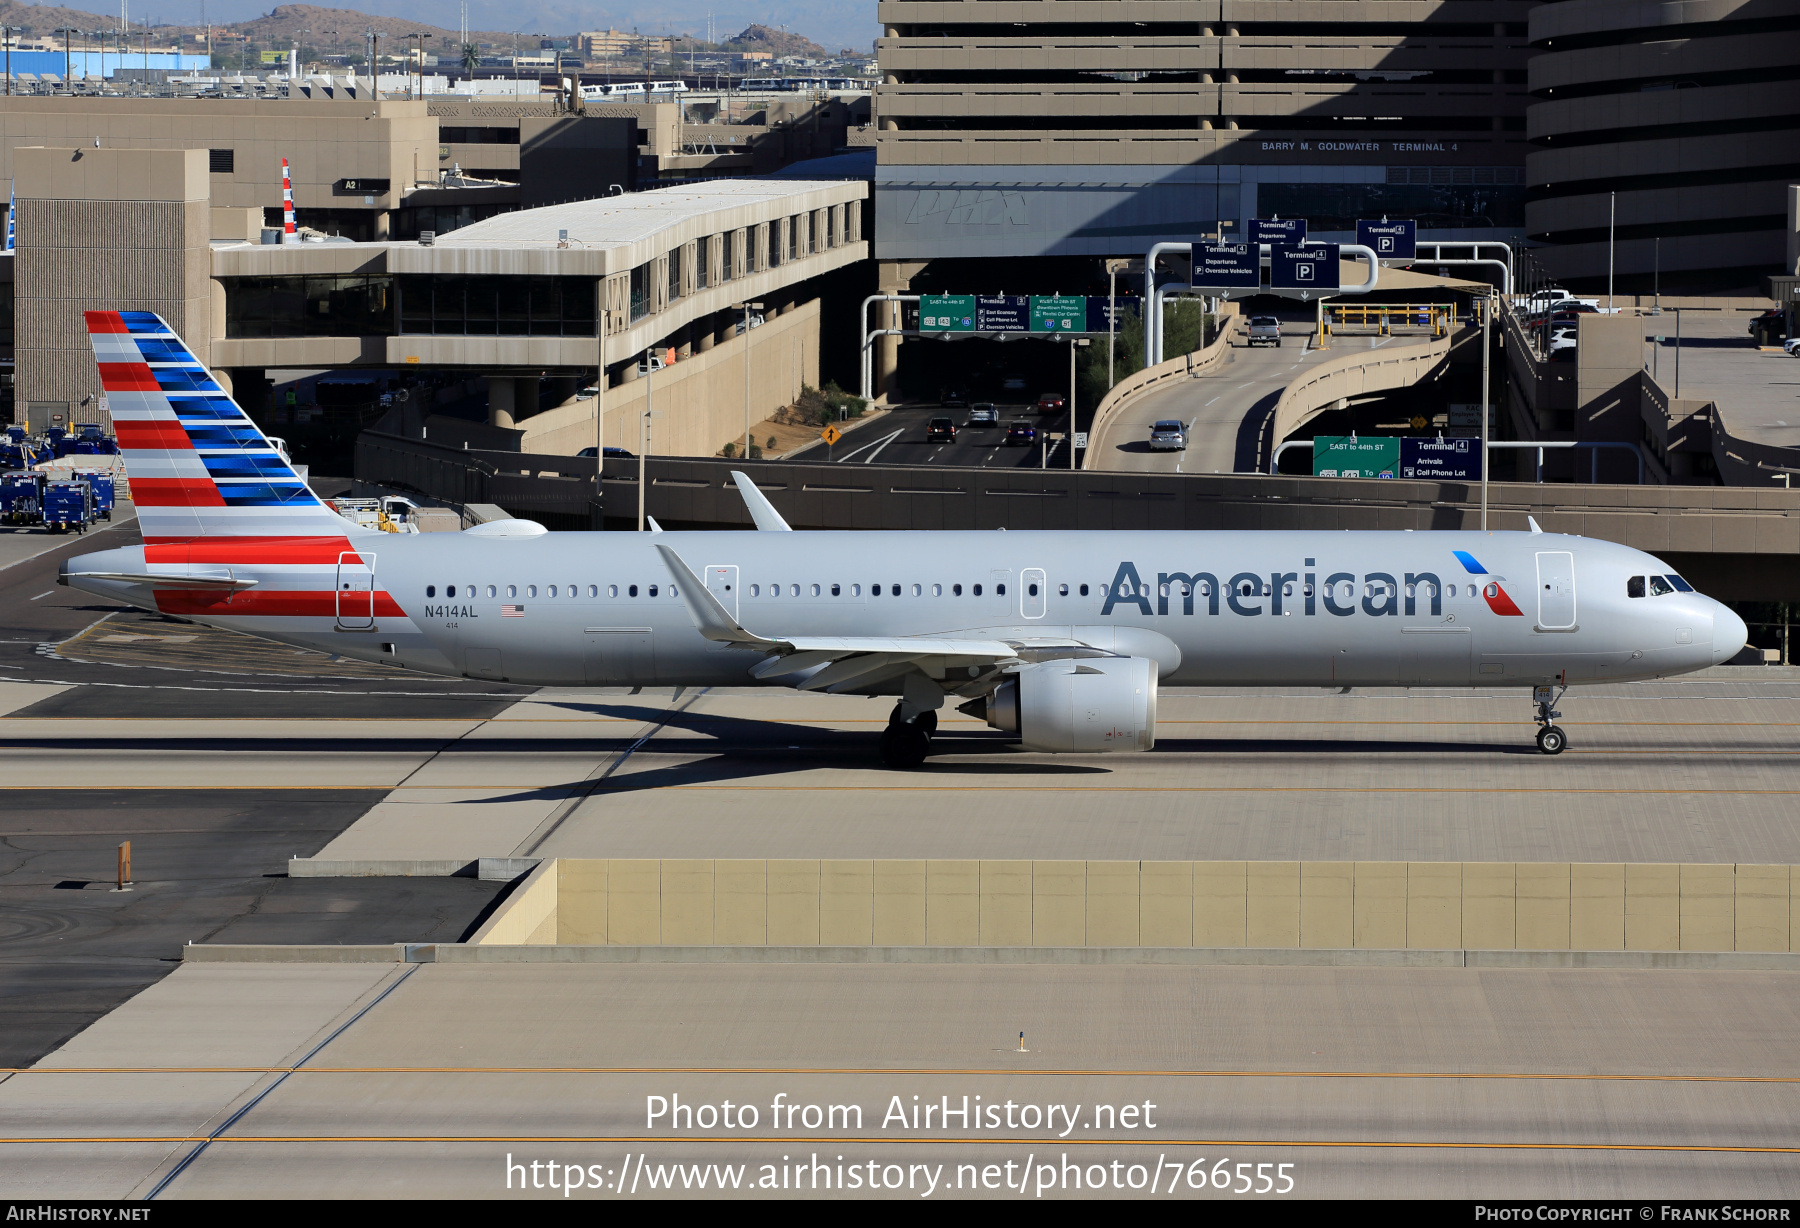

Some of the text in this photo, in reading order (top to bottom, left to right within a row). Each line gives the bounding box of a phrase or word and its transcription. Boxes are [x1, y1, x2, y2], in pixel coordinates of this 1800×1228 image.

[1262, 142, 1458, 151] BARRY M. GOLDWATER TERMINAL 4
[345, 181, 356, 189] A2
[1259, 221, 1286, 229] Terminal
[1205, 245, 1236, 253] Terminal
[1381, 239, 1390, 250] P
[1284, 251, 1316, 259] Terminal
[1300, 265, 1310, 278] P
[1418, 442, 1455, 450] Terminal
[23, 500, 37, 513] A18
[1100, 557, 1442, 617] American
[425, 605, 478, 618] N414AL
